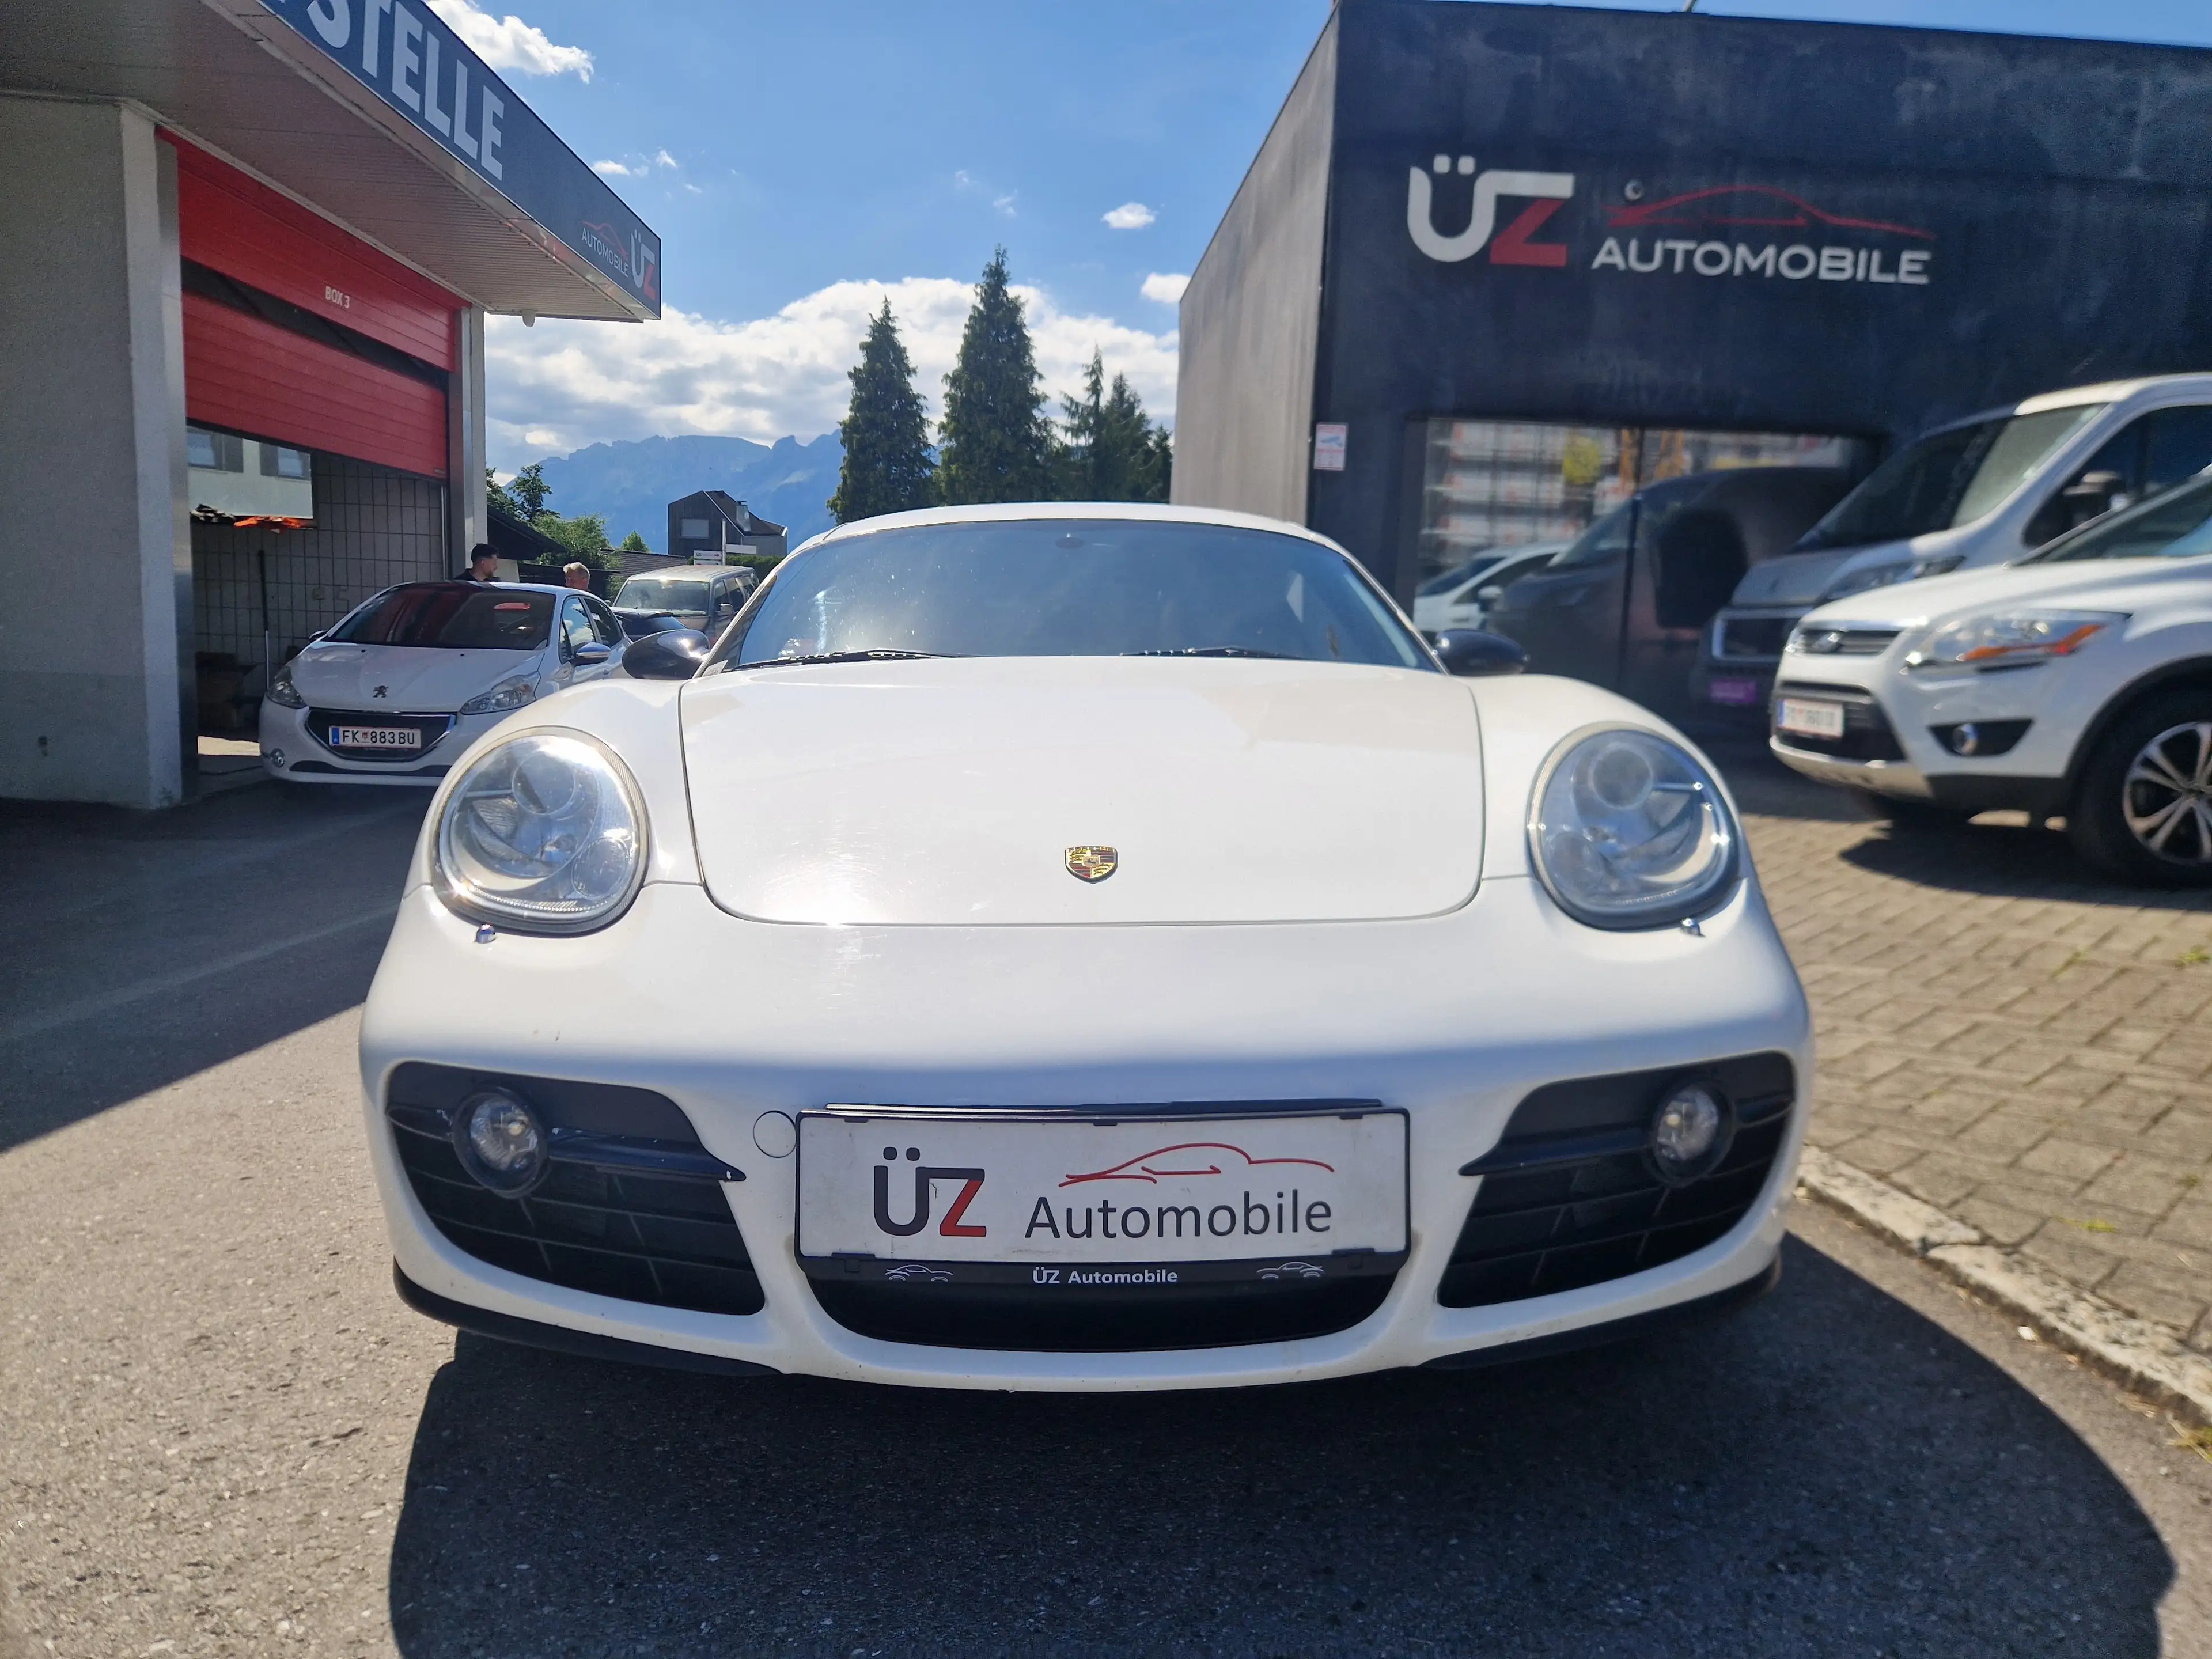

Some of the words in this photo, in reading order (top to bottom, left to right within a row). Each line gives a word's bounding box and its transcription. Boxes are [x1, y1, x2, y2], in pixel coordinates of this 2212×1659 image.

[1407, 154, 1575, 267] ÜZ
[1591, 238, 1931, 286] AUTOMOBILE
[582, 228, 629, 278] AUTOMOBILE
[631, 229, 656, 300] ÜZ
[325, 286, 343, 306] BOX
[344, 294, 350, 309] 3
[342, 730, 359, 743] FK
[873, 1146, 987, 1237] ÜZ
[1025, 1188, 1332, 1239] Automobile
[1032, 1267, 1060, 1285] ÜZ
[1067, 1268, 1178, 1285] Automobile
